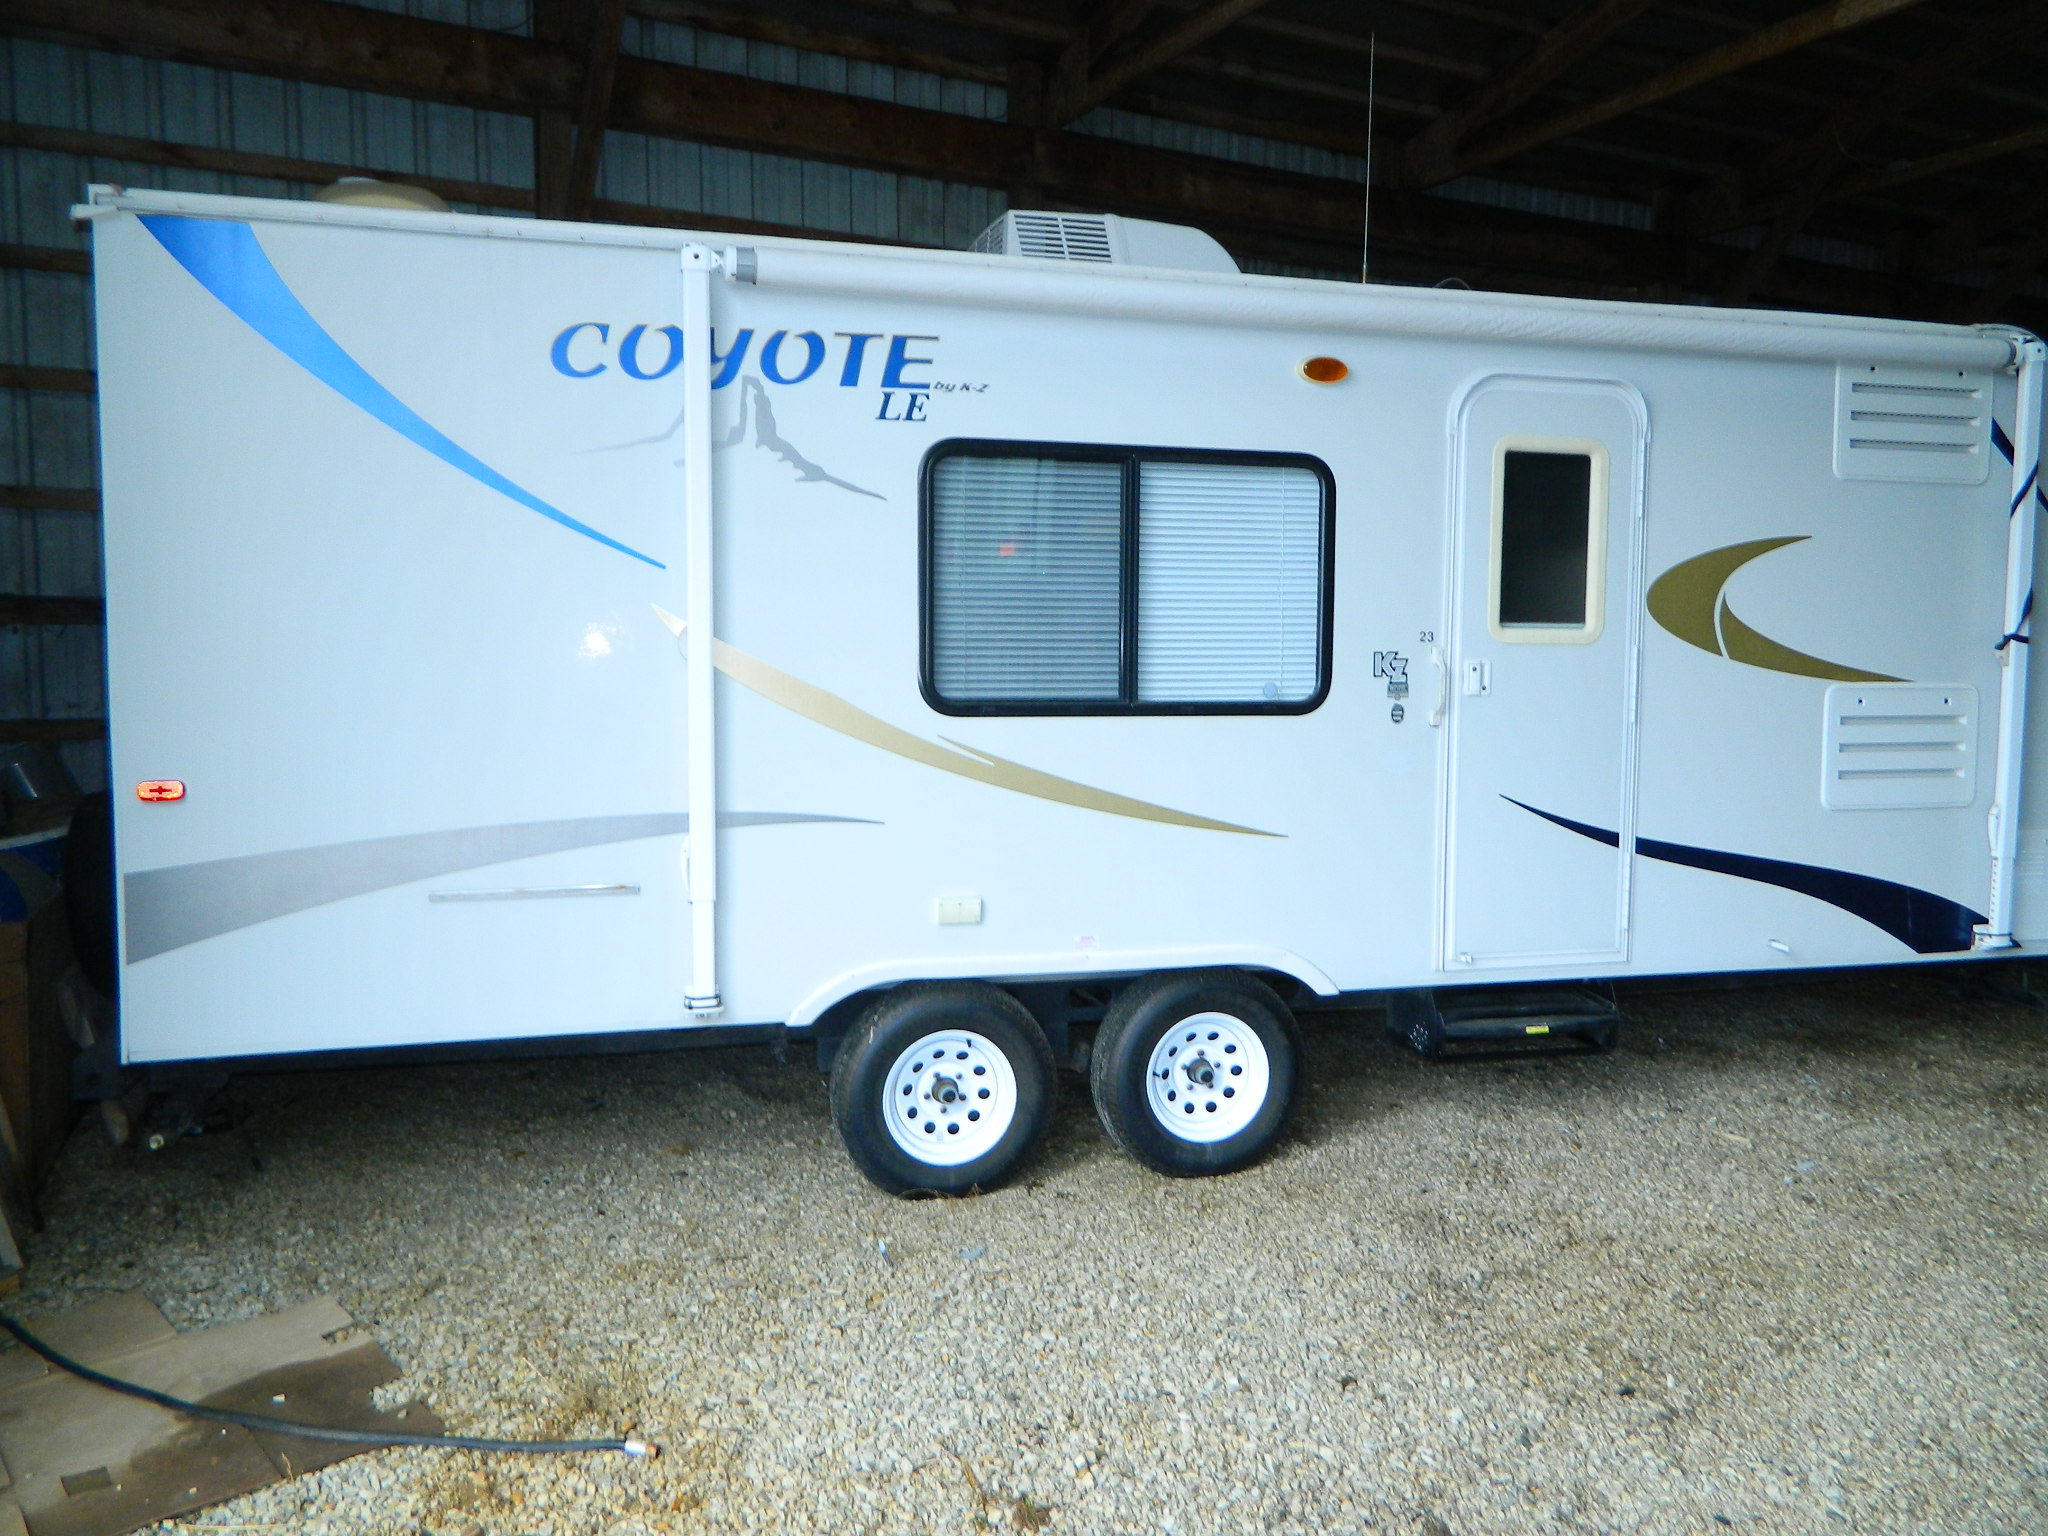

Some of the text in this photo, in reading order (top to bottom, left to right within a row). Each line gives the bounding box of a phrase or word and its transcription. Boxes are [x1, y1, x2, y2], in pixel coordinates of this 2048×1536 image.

[933, 381, 956, 392] by
[875, 391, 930, 421] LE
[1419, 631, 1434, 642] 23
[1373, 651, 1408, 684] KZ
